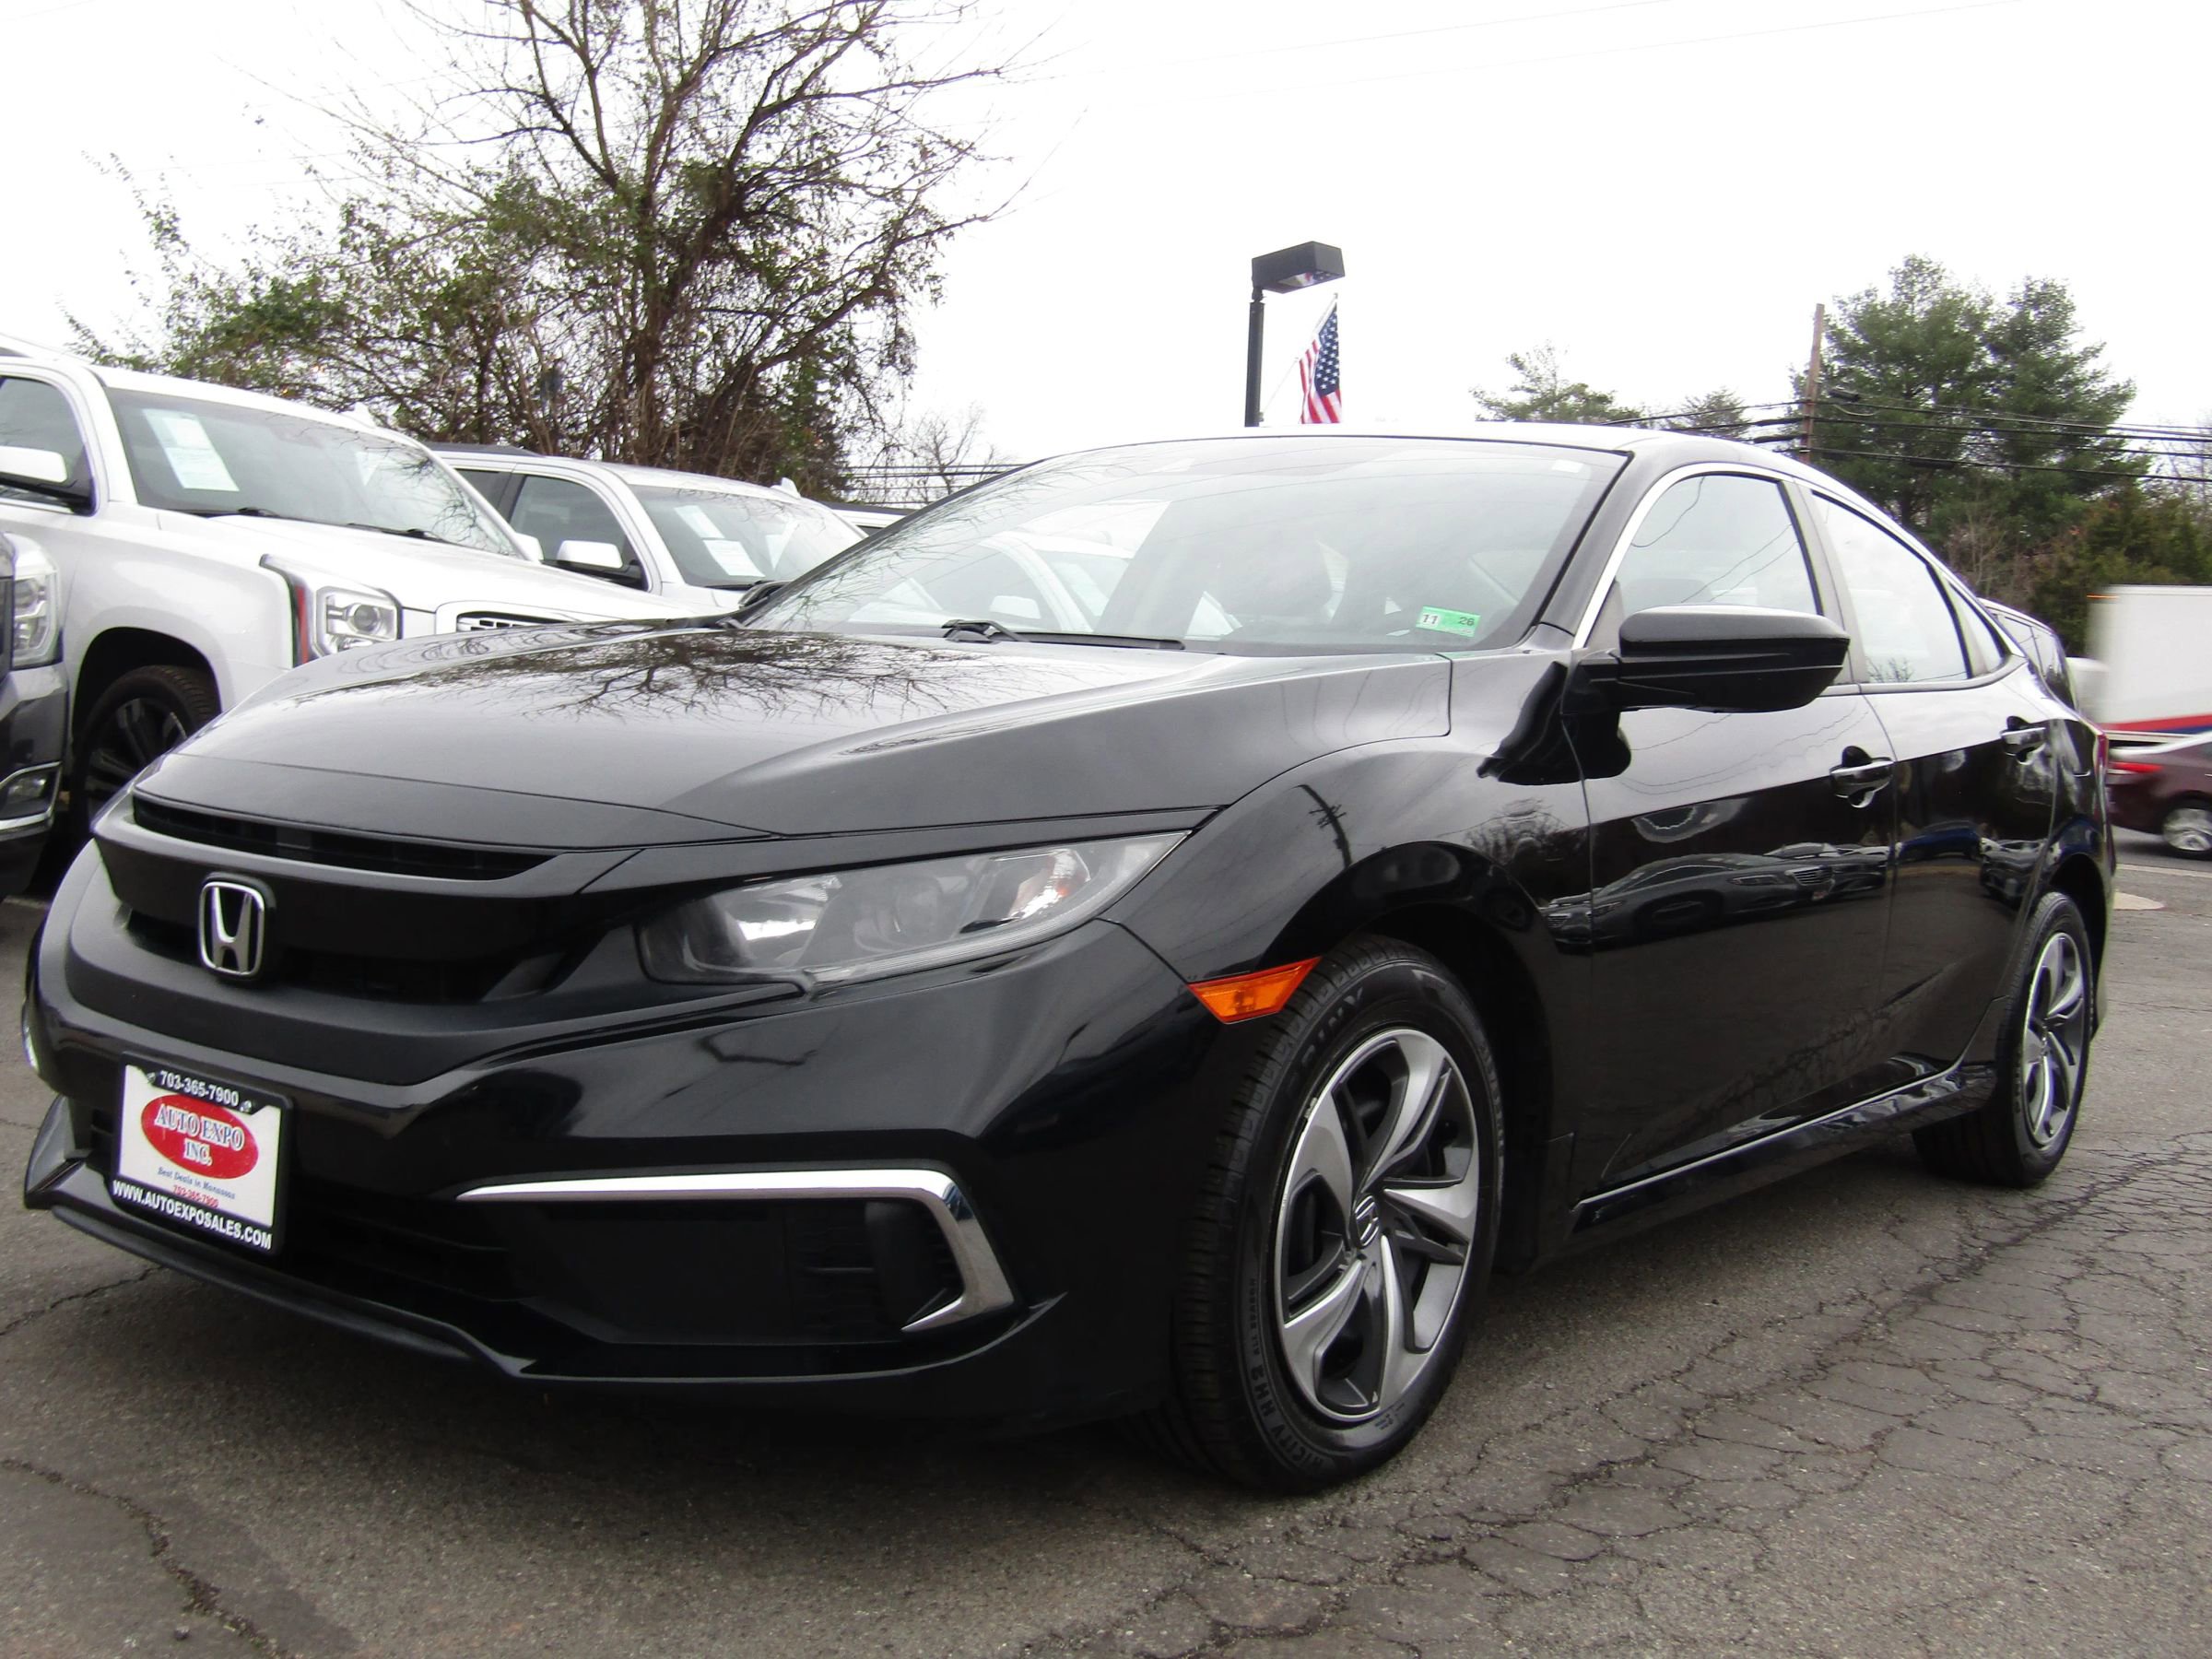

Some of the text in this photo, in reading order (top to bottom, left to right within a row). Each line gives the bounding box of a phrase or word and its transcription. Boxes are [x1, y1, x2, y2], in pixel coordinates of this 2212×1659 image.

[1422, 614, 1438, 625] 11
[1459, 617, 1475, 627] 26
[159, 1070, 240, 1107] 703-365-7900
[154, 1103, 245, 1151] AUTO EXPO
[183, 1138, 213, 1166] INC.
[112, 1180, 273, 1251] WWW.AUTOEXPOSALES.COM
